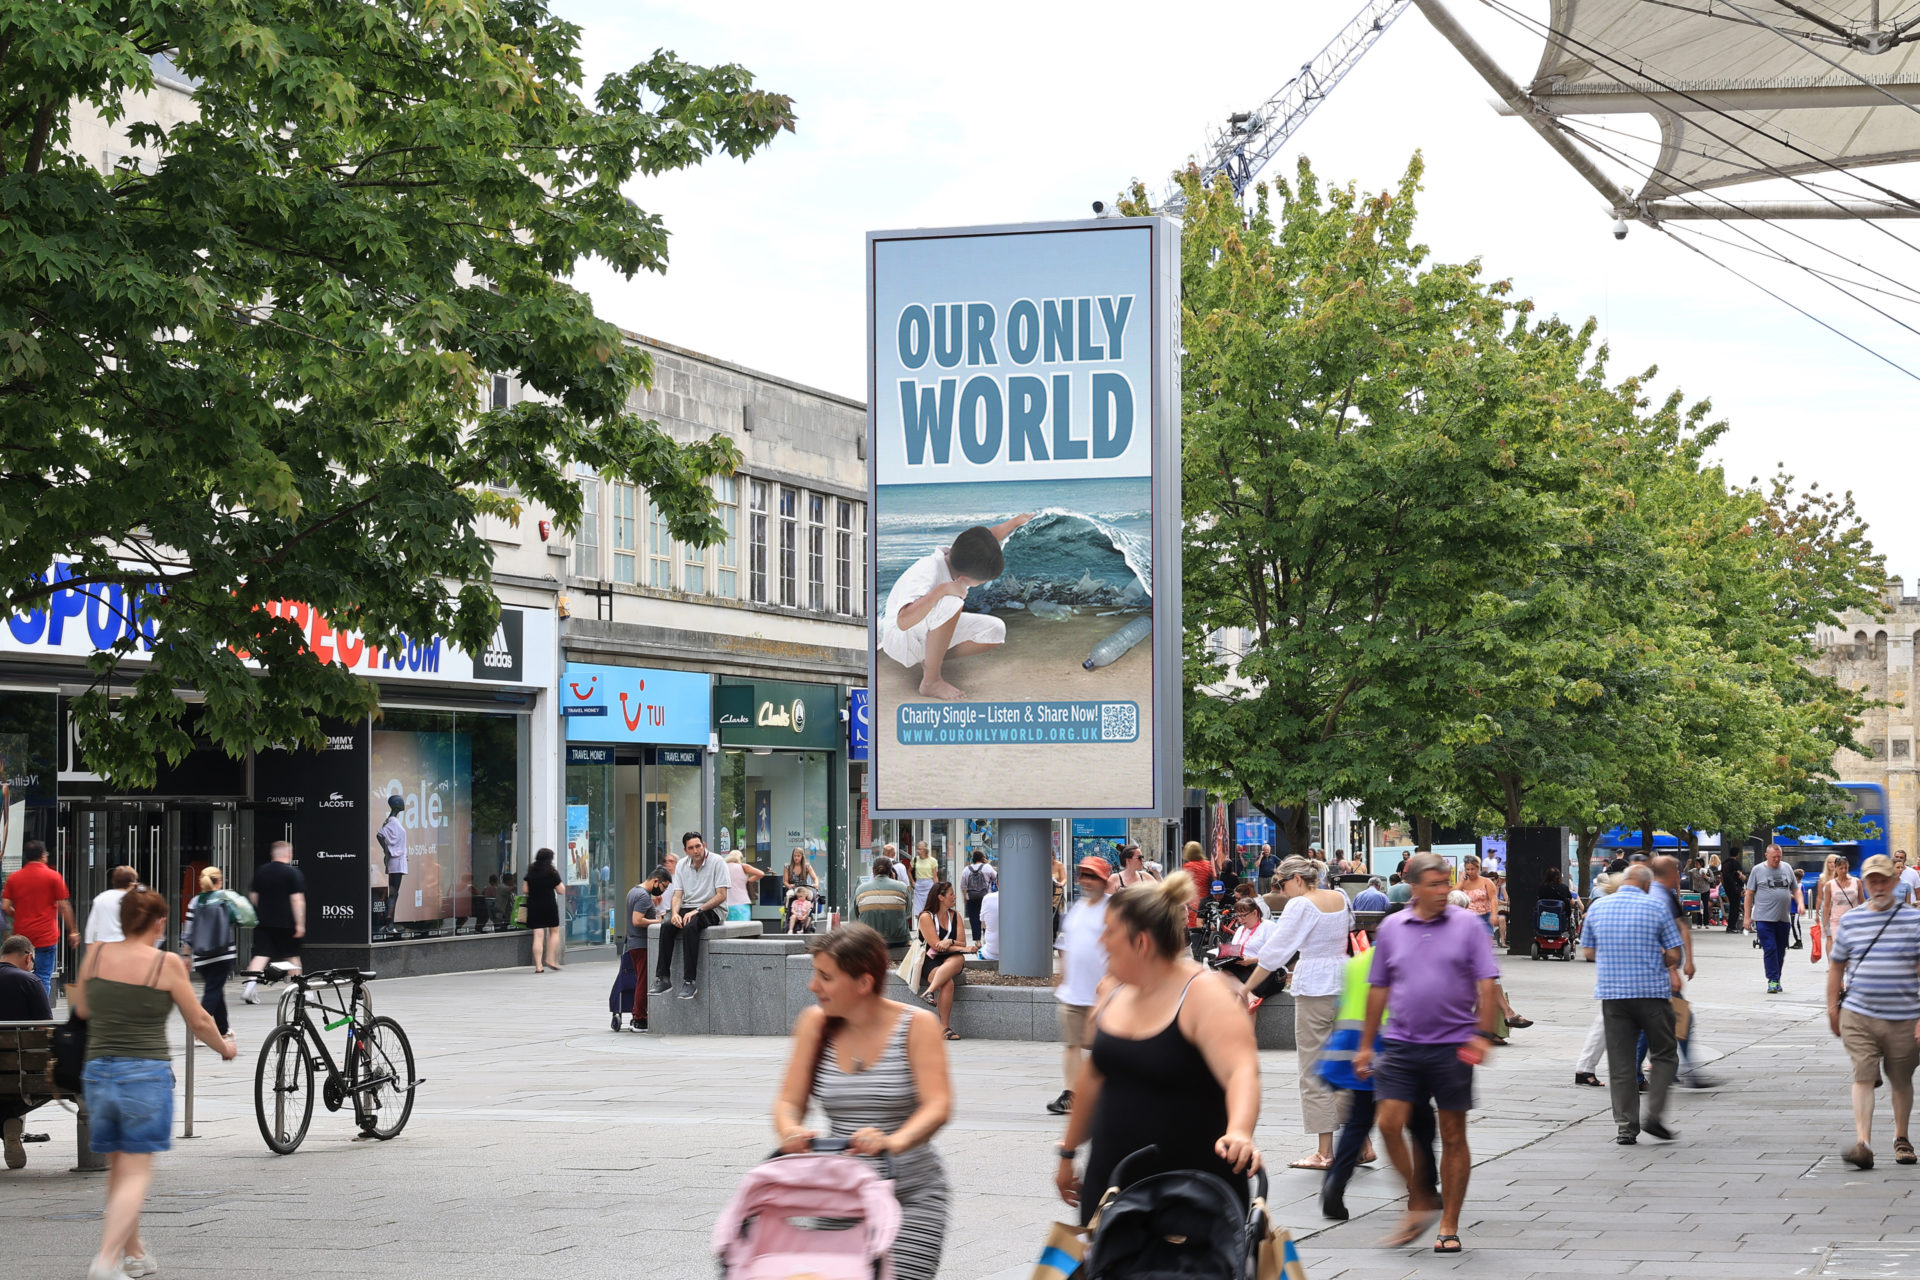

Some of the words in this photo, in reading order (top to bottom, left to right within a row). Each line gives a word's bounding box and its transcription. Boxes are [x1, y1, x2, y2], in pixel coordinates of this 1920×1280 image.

[897, 302, 999, 369] OUR
[1006, 294, 1135, 366] ONLY
[897, 371, 1136, 467] WORLD
[483, 651, 513, 669] adidas
[646, 705, 666, 727] TUI
[719, 713, 749, 724] Clarks
[758, 701, 790, 727] Clarks
[901, 706, 941, 728] Charity
[943, 706, 977, 728] Single
[987, 704, 1020, 724] Listen
[1024, 705, 1034, 723] &
[1038, 704, 1069, 723] Share
[1071, 704, 1098, 723] Now!
[326, 736, 354, 745] OMMY
[902, 727, 1098, 743] WWW.OURONLYWORLD.ORG.UK
[572, 749, 590, 761] TRAVEL
[590, 750, 607, 762] MONEY
[664, 751, 680, 762] TRAVEL
[680, 752, 695, 763] MONEY
[319, 800, 355, 808] LACOSTE
[316, 850, 357, 861] Champion
[322, 905, 355, 916] BOSS
